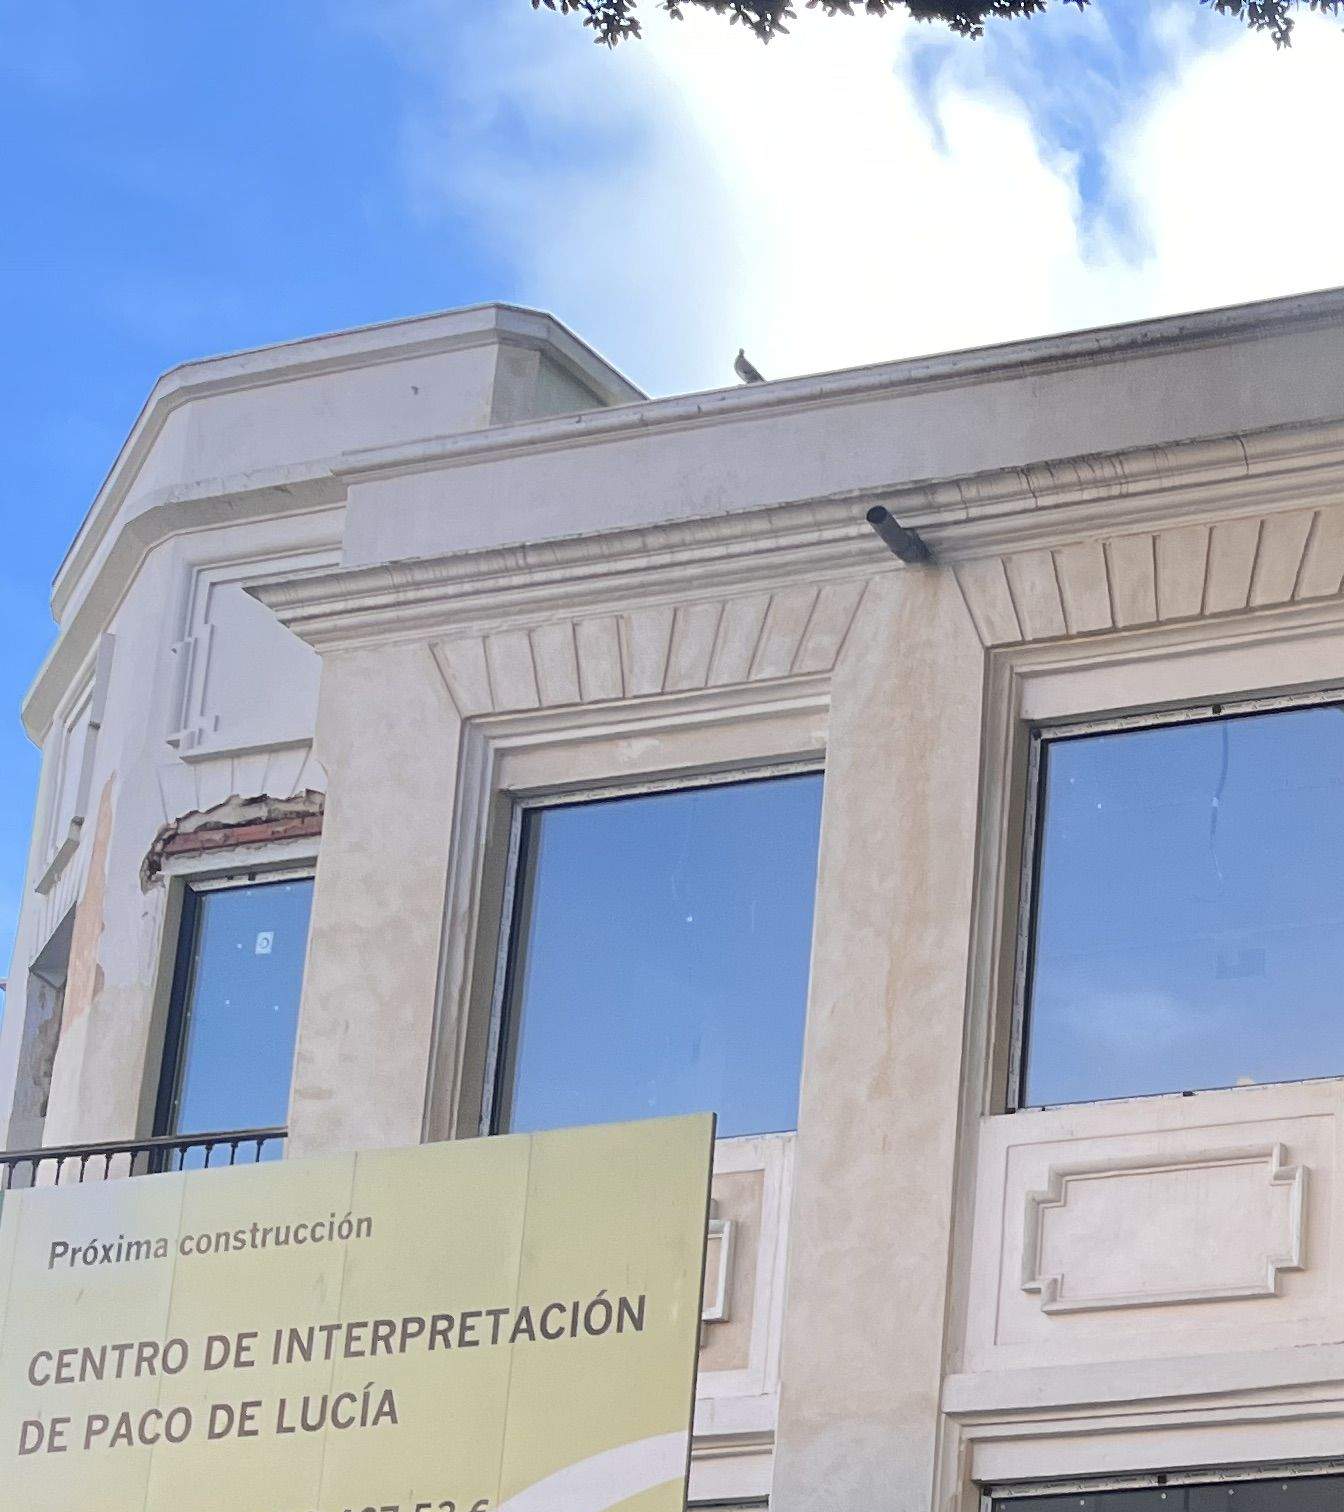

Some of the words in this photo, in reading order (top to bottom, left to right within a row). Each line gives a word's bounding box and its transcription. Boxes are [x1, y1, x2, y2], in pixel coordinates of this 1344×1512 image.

[48, 1234, 169, 1270] Próxima
[179, 1211, 373, 1257] construcción
[27, 1337, 190, 1387] CENTRO
[203, 1331, 259, 1371] DE
[271, 1289, 646, 1365] INTERPRETACIÓN
[18, 1416, 71, 1456] DE
[83, 1406, 193, 1450] PACO
[207, 1400, 263, 1441] DE
[275, 1381, 399, 1434] LUCÍA
